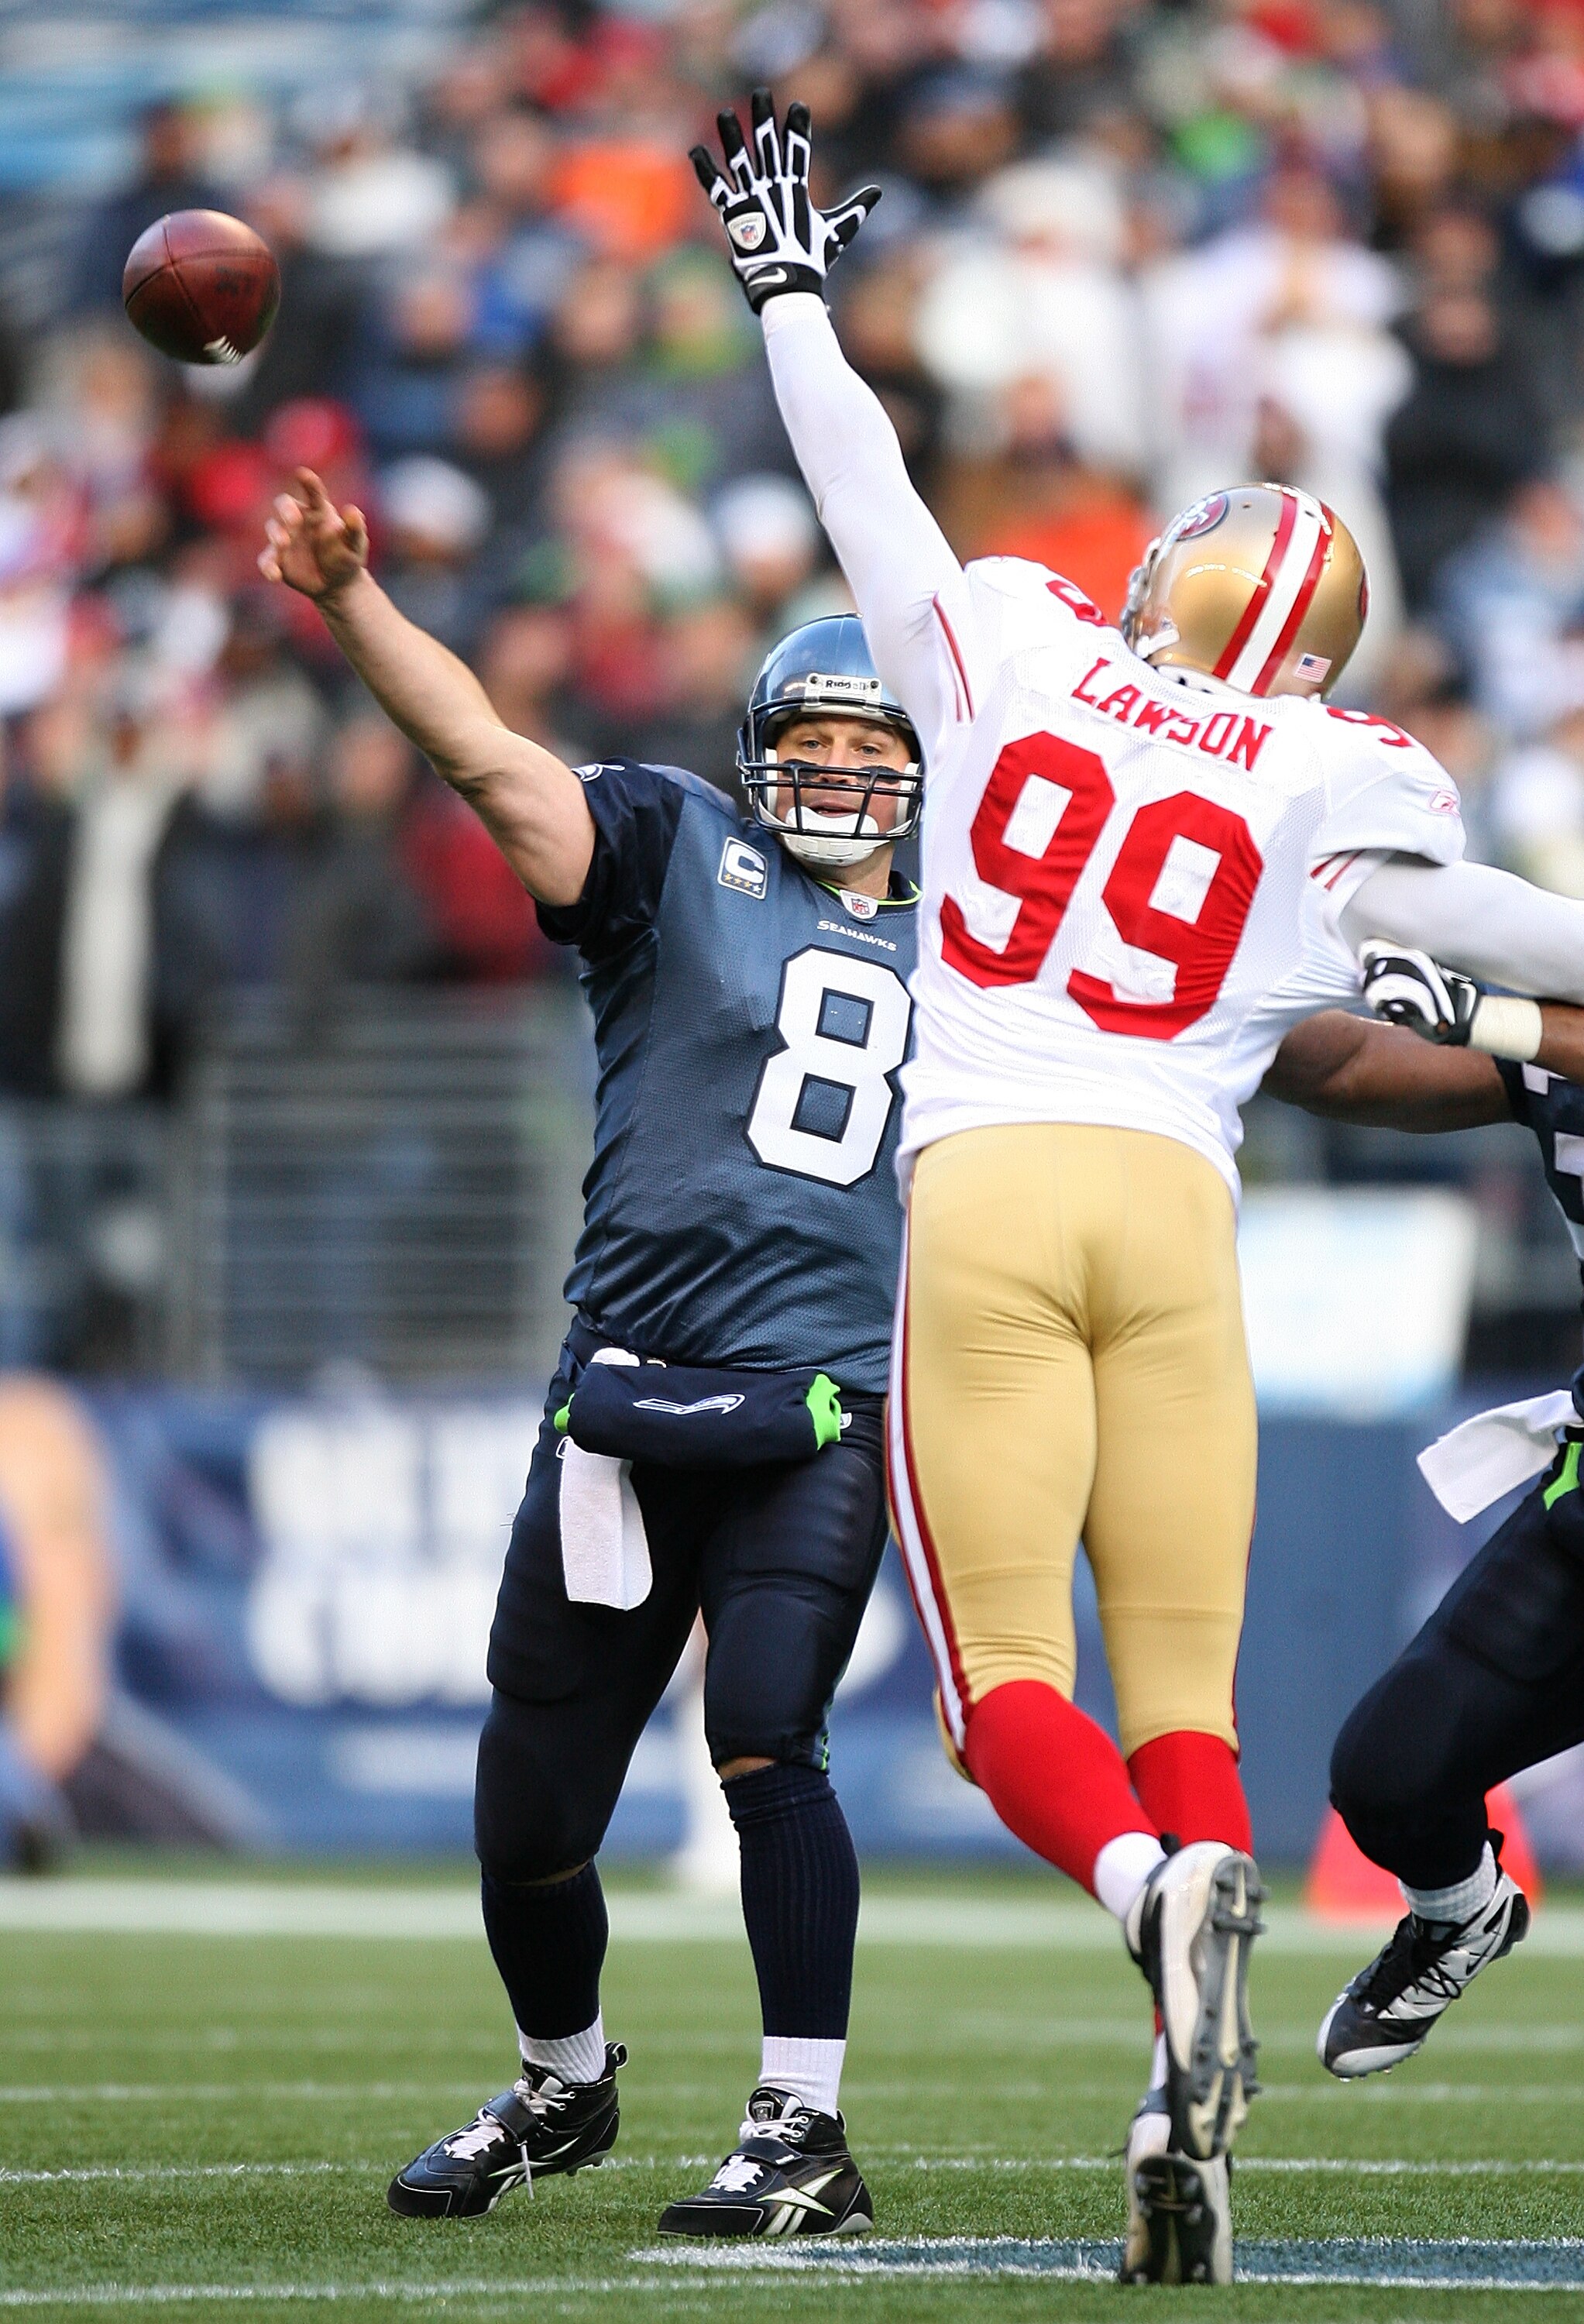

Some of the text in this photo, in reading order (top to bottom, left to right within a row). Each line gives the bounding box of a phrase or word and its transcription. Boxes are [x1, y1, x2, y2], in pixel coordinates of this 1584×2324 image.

[1070, 657, 1275, 772] LAWSON
[724, 843, 765, 884] C
[940, 730, 1266, 1043] 99
[816, 920, 898, 952] SEAHAWKS
[744, 944, 914, 1191] 8
